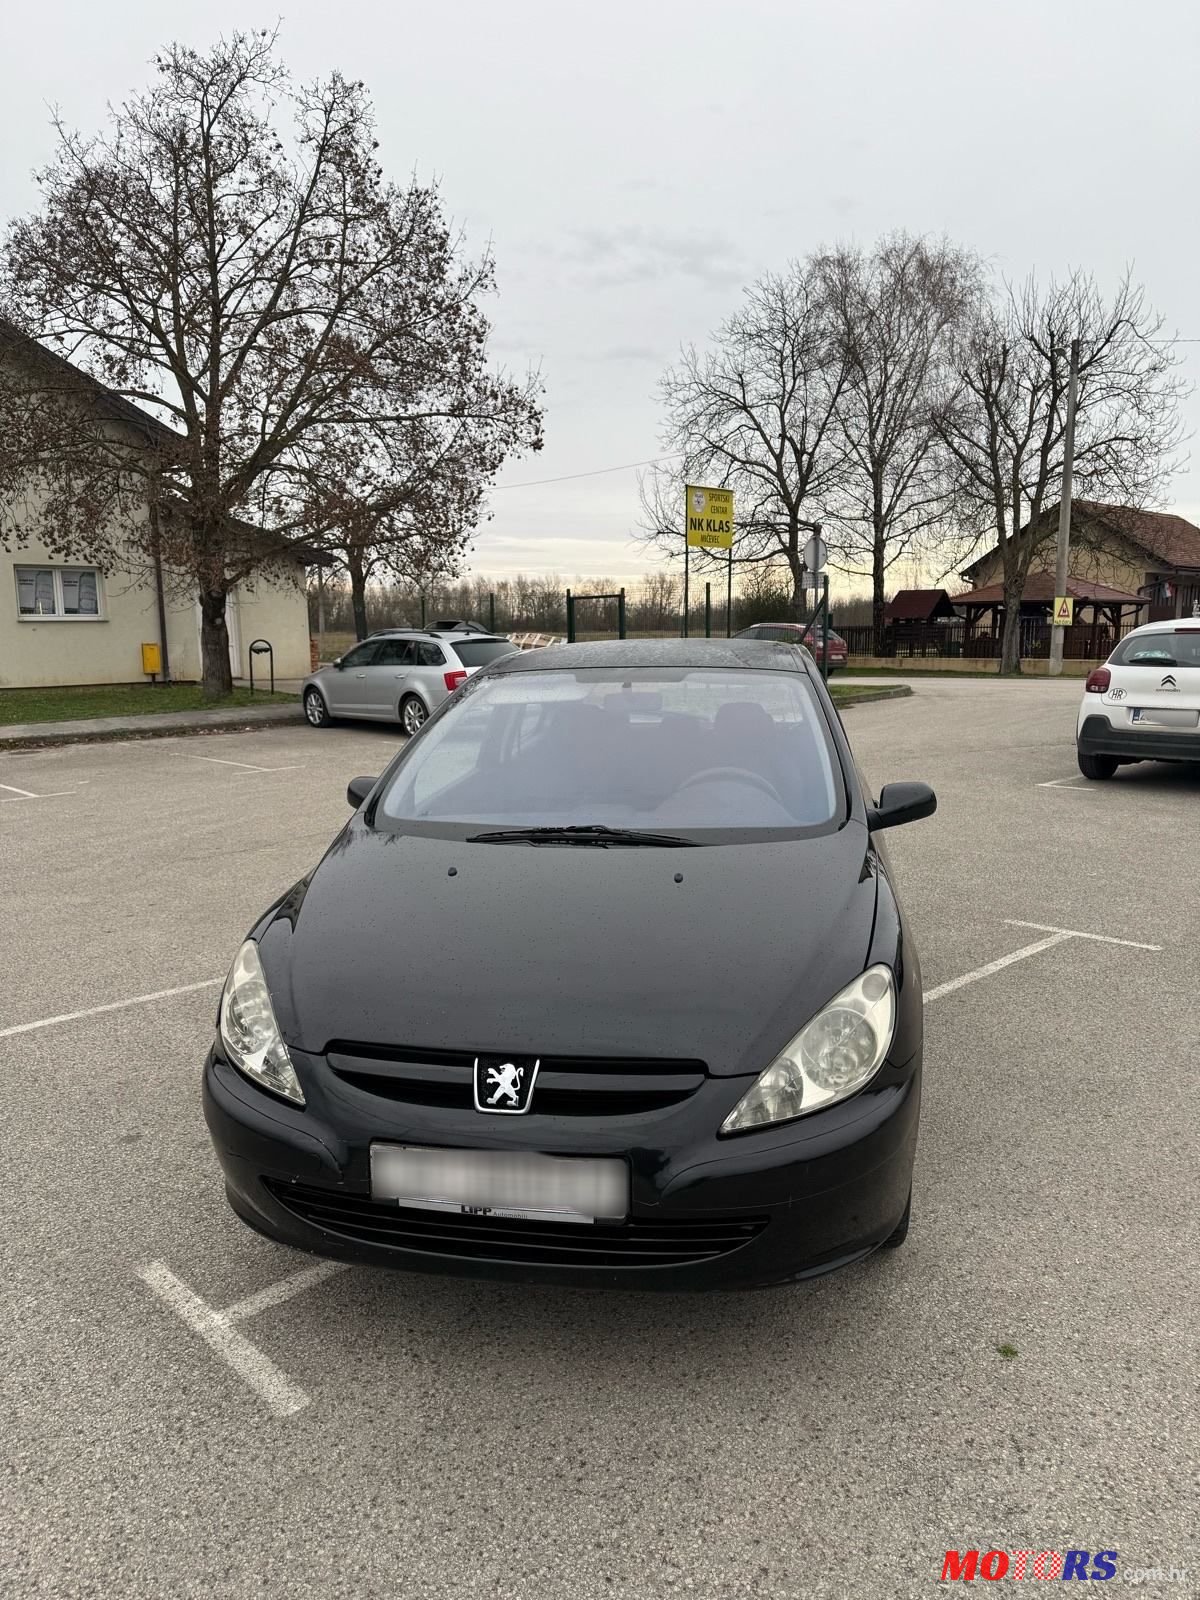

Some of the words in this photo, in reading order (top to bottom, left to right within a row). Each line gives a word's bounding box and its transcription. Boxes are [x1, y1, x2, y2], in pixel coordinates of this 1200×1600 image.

[709, 493, 730, 503] SPORTSKI
[711, 506, 728, 514] CENTAR
[690, 517, 704, 531] NK
[706, 519, 731, 533] KLAS
[1111, 689, 1124, 699] HR
